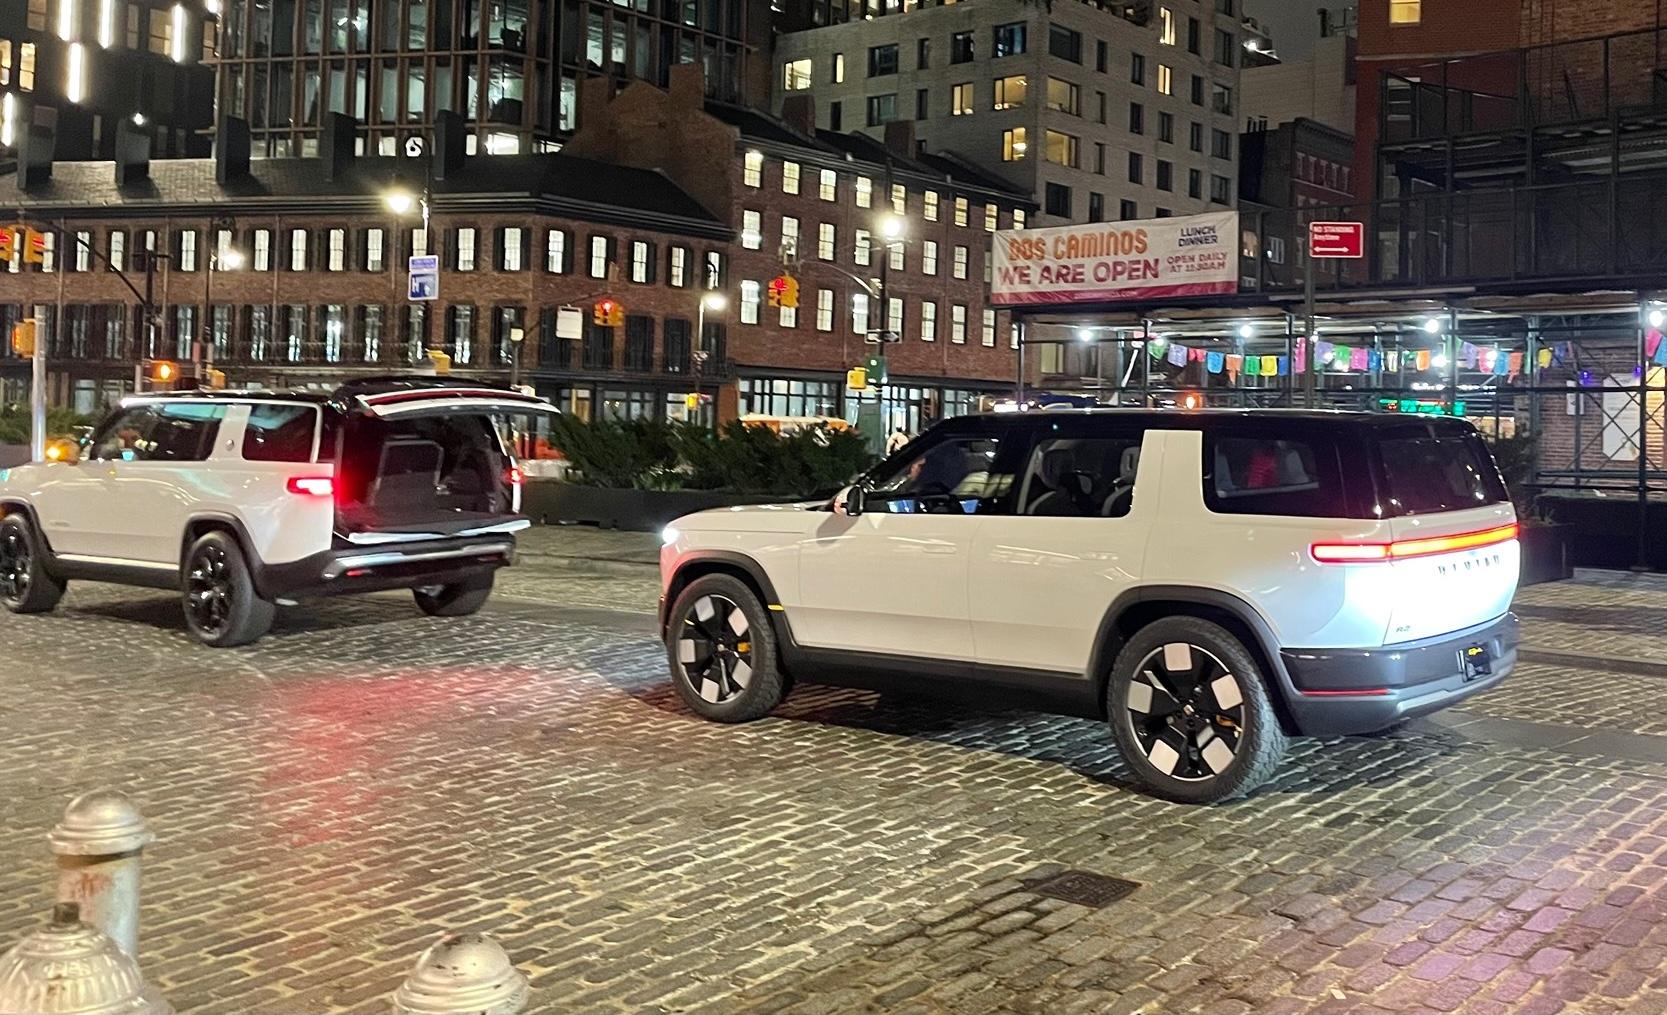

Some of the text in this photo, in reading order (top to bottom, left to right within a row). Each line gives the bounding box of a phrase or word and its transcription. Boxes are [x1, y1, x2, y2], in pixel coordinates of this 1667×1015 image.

[1180, 225, 1216, 237] LUNCH
[1008, 228, 1148, 261] DOS CAMINOS
[1178, 235, 1218, 247] DINNER
[1167, 252, 1228, 264] OPEN DAILY
[998, 258, 1160, 285] WE ARE OPEN
[1170, 264, 1182, 273] AT
